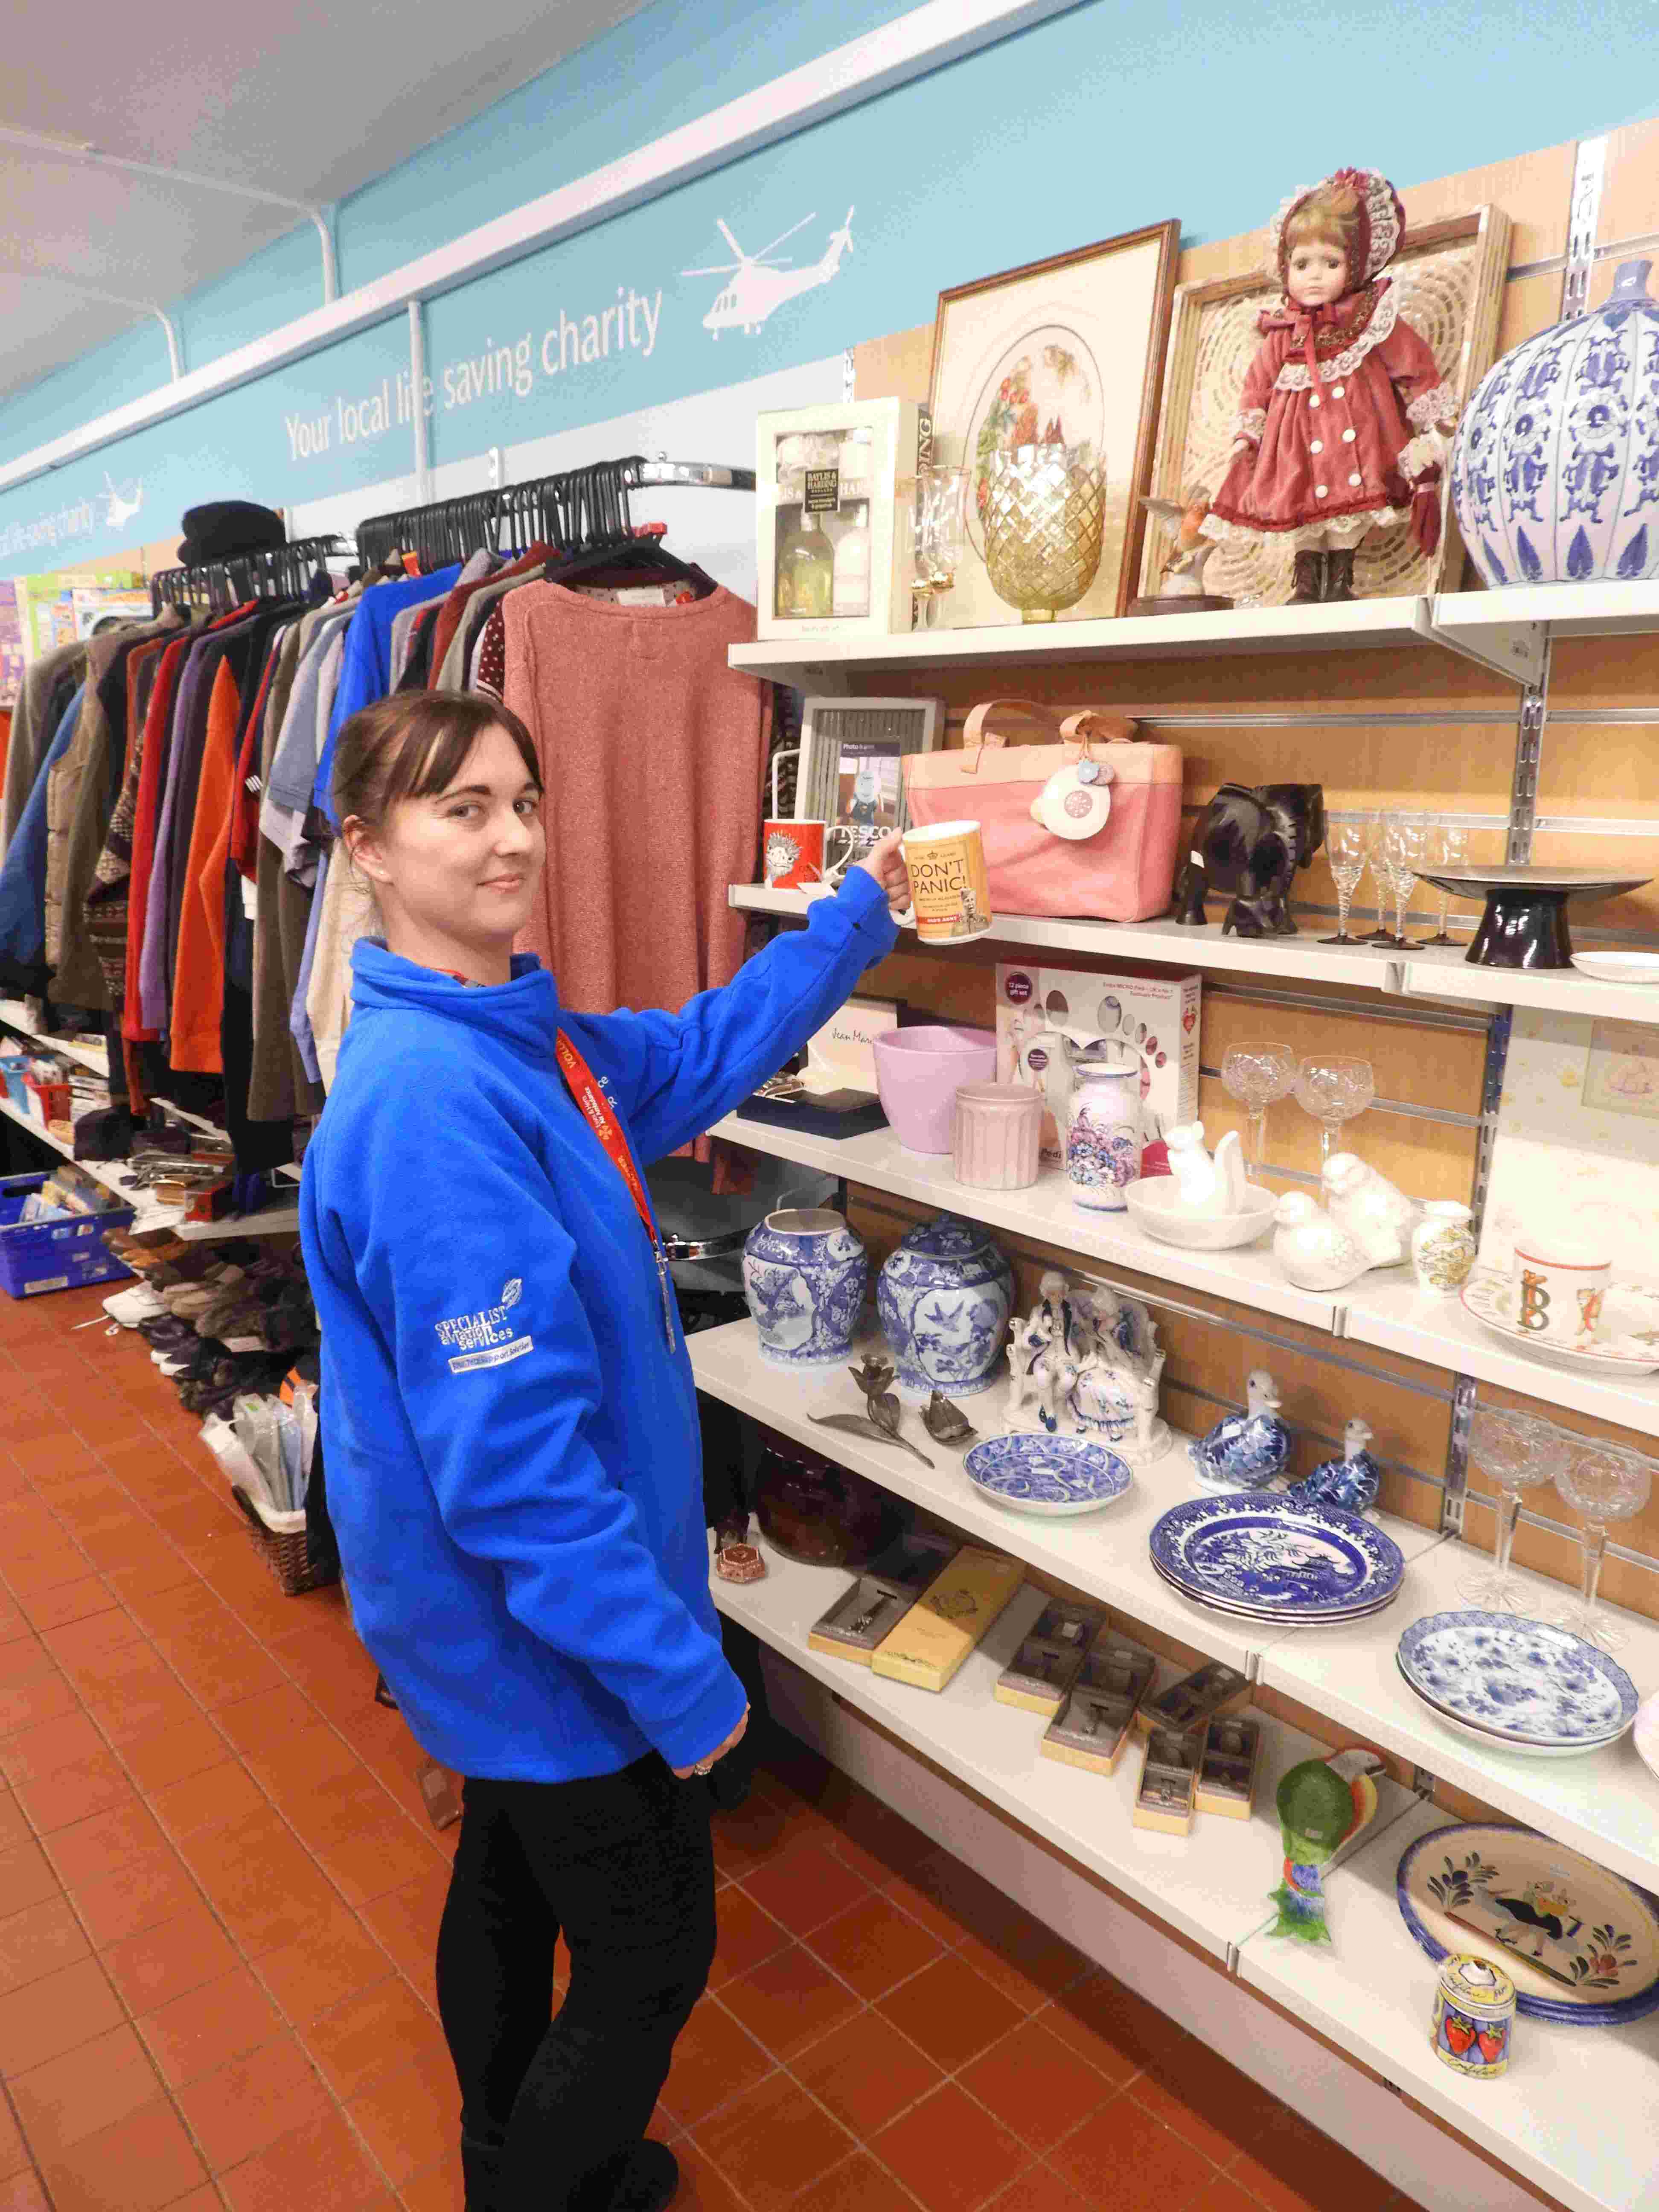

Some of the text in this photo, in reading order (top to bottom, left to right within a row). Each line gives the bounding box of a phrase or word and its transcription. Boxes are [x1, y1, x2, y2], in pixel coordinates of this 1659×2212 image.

[285, 286, 663, 461] Your local lie saving charity
[911, 859, 963, 878] DON'T
[914, 875, 966, 894] PANIC!
[434, 1305, 507, 1338] SPECIALIST
[441, 1325, 492, 1345] aviation
[458, 1327, 513, 1350] services
